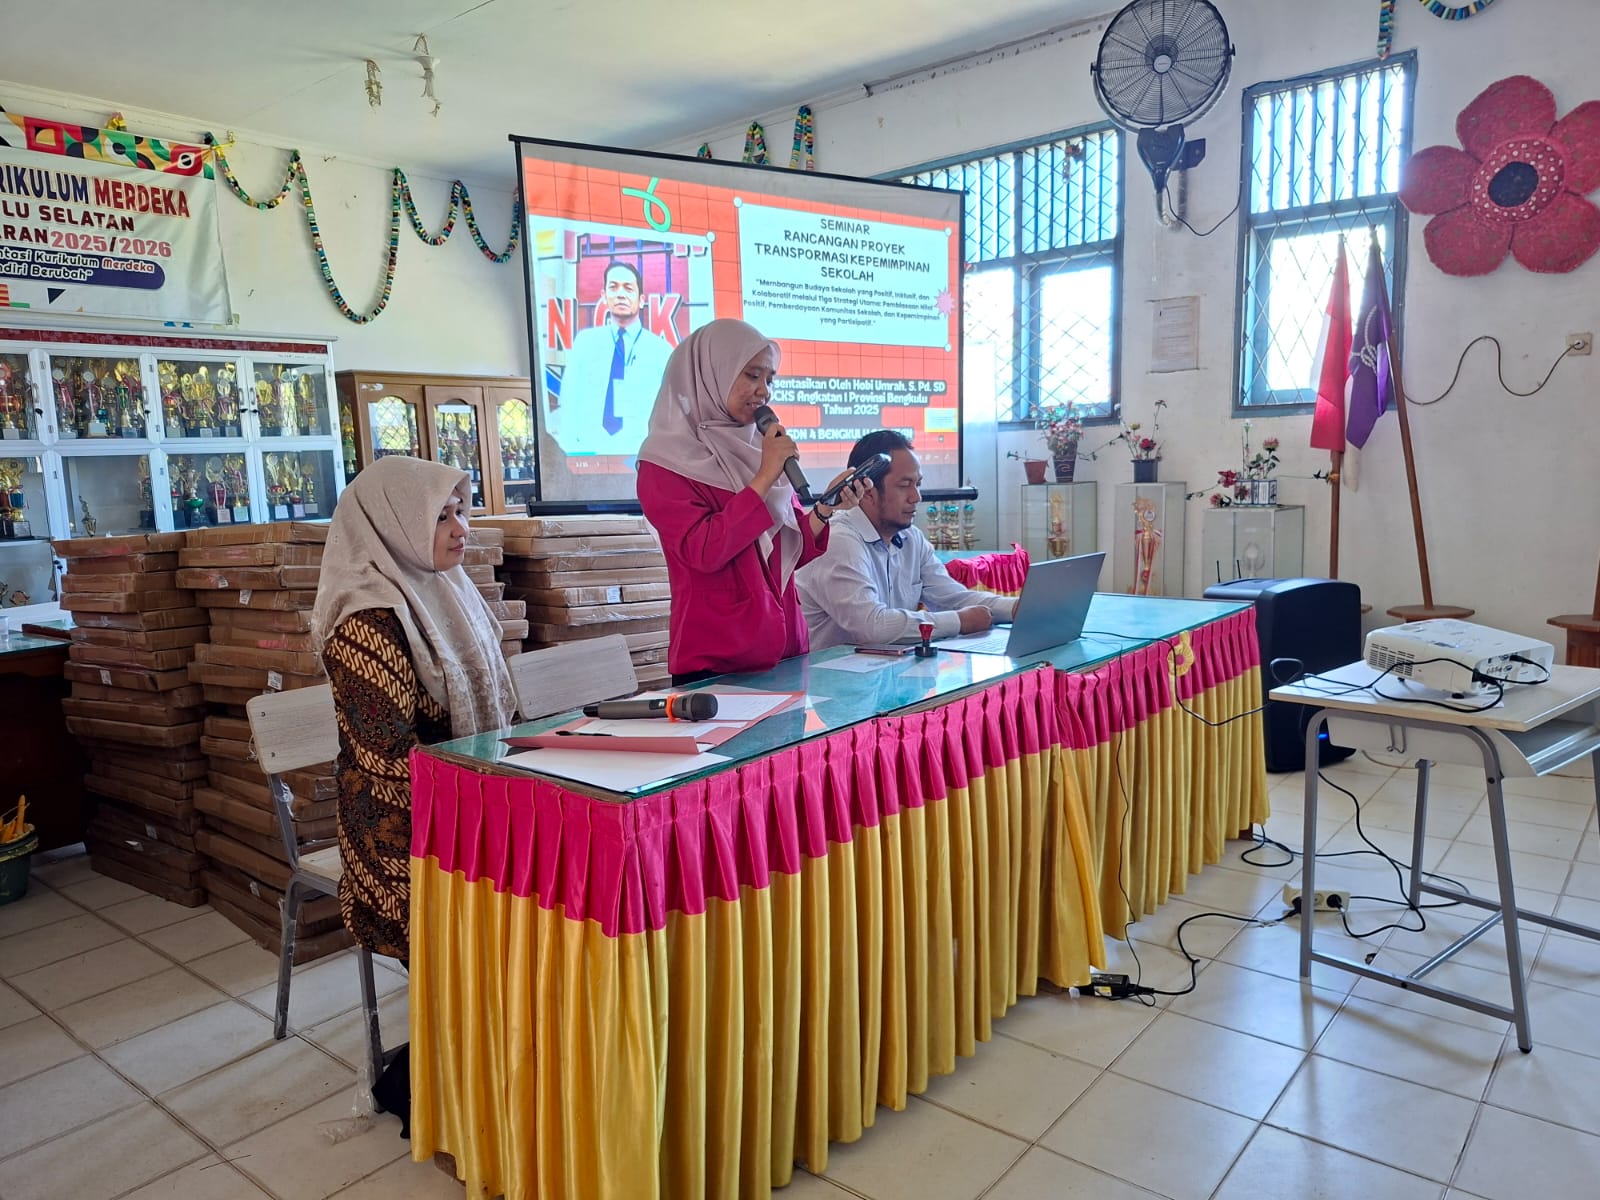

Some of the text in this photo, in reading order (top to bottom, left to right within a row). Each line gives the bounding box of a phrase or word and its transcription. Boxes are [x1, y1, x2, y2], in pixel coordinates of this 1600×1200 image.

[94, 177, 191, 218] MERDEKA
[2, 200, 135, 231] LU SELATAN
[820, 218, 870, 235] SEMINAR
[0, 224, 172, 257] RAN 2025/2026
[784, 229, 905, 255] RANCANGAN PROYEK
[36, 251, 99, 267] Kurikulum
[103, 259, 154, 272] Merdeka
[754, 242, 930, 273] TRANSPORMASI KEPEMIMPINAN
[820, 266, 874, 282] SEKOLAH
[804, 283, 830, 293] Budaya
[831, 286, 856, 295] Sekolah
[857, 289, 873, 298] yang
[874, 290, 894, 298] Positif,
[743, 299, 767, 309] Positif,
[768, 302, 820, 313] Pemberdayaan
[821, 306, 856, 315] Komunitas
[857, 308, 882, 317] Sekolah,
[752, 289, 791, 299] Kolaboratif
[792, 293, 817, 302] melalui
[818, 295, 832, 304] Tiga
[833, 297, 859, 306] Strategi
[883, 301, 919, 310] Pembiasaan
[820, 318, 837, 326] yang
[774, 377, 827, 390] sentasikan
[828, 379, 852, 391] Oleh
[853, 379, 873, 391] Hobi
[908, 381, 918, 392] S.
[918, 382, 932, 392] Pd.
[933, 382, 946, 392] SD
[797, 391, 842, 405] Angkatan
[849, 391, 886, 403] Provinsi
[887, 393, 928, 406] Bengkulu
[822, 403, 880, 415] Tahun 2025
[786, 428, 808, 439] SDN
[809, 428, 816, 440] 4
